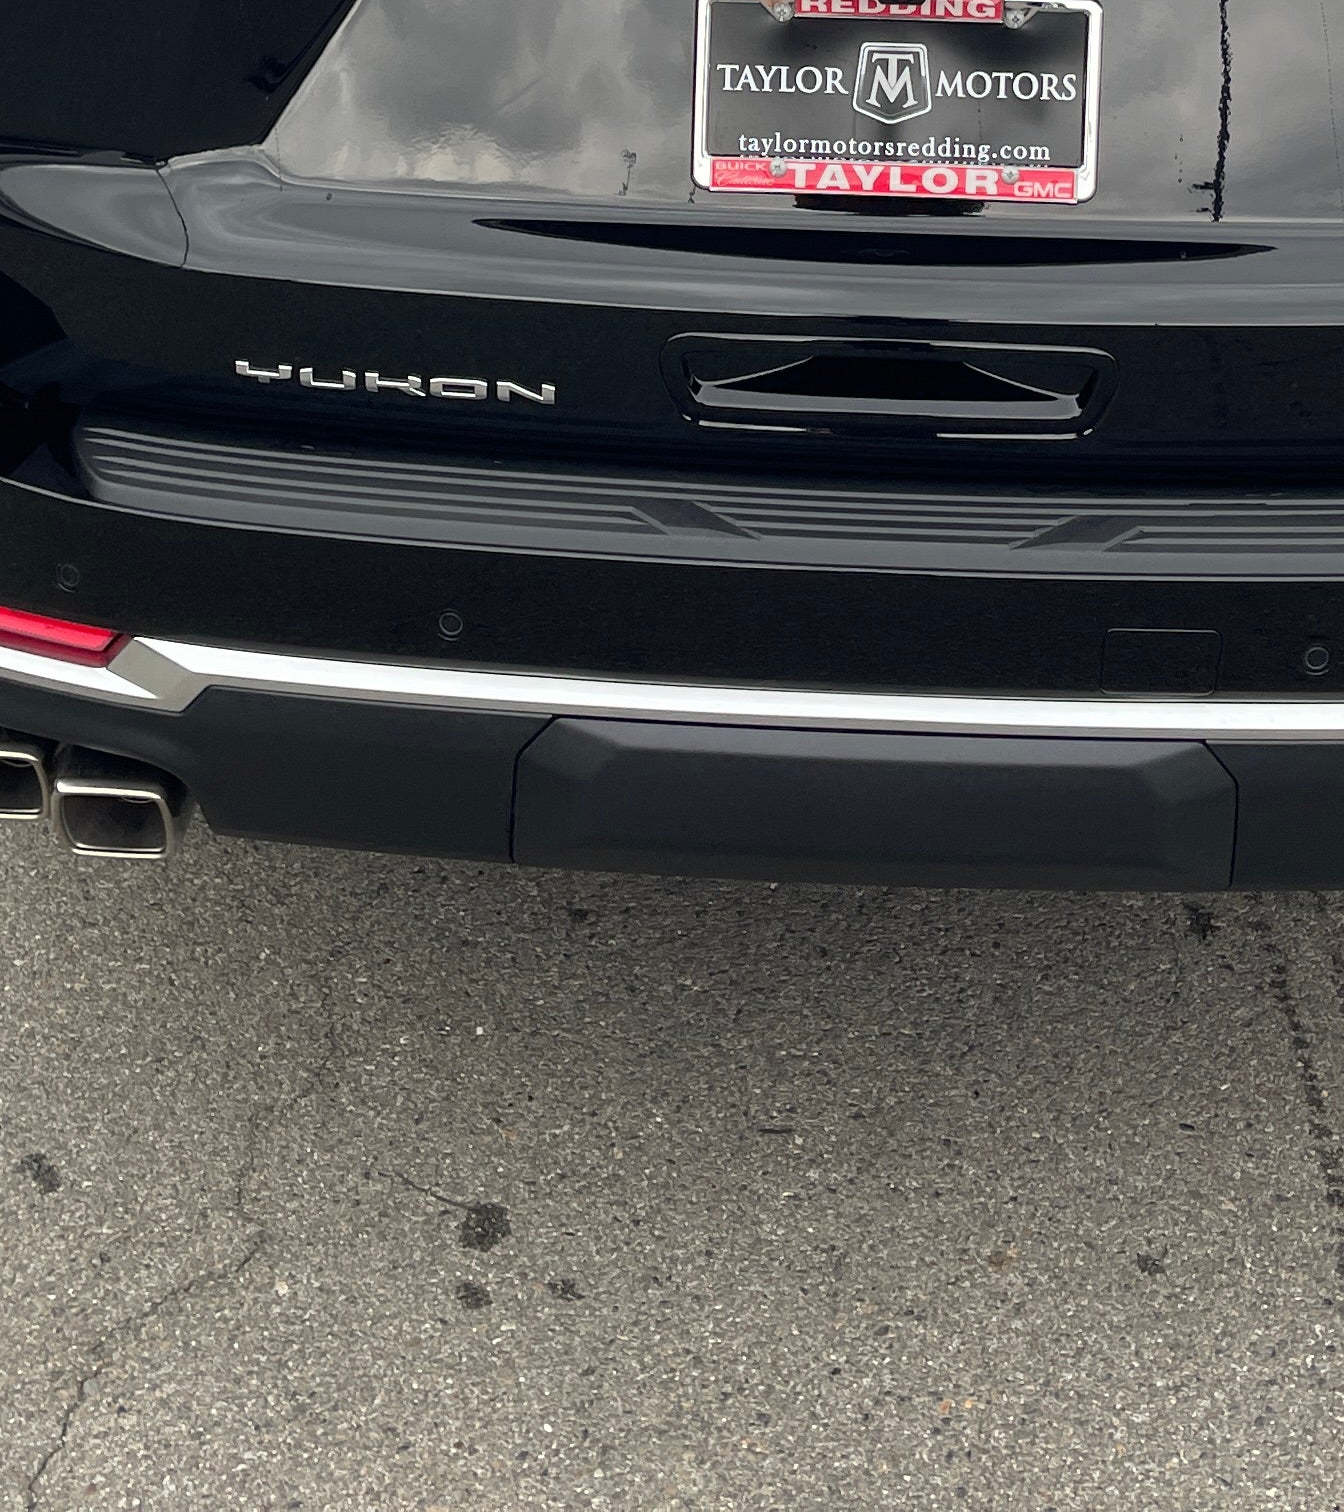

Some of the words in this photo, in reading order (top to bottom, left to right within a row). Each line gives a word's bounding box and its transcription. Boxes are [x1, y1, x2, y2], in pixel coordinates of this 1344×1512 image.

[716, 64, 849, 95] TAYLOR
[935, 70, 1077, 101] MOTORS
[738, 131, 1051, 163] taylormotorsredding.com
[715, 161, 767, 172] BUICK
[787, 162, 1000, 196] TAYLOR
[1013, 181, 1073, 198] GMC
[235, 360, 556, 405] YUKON
